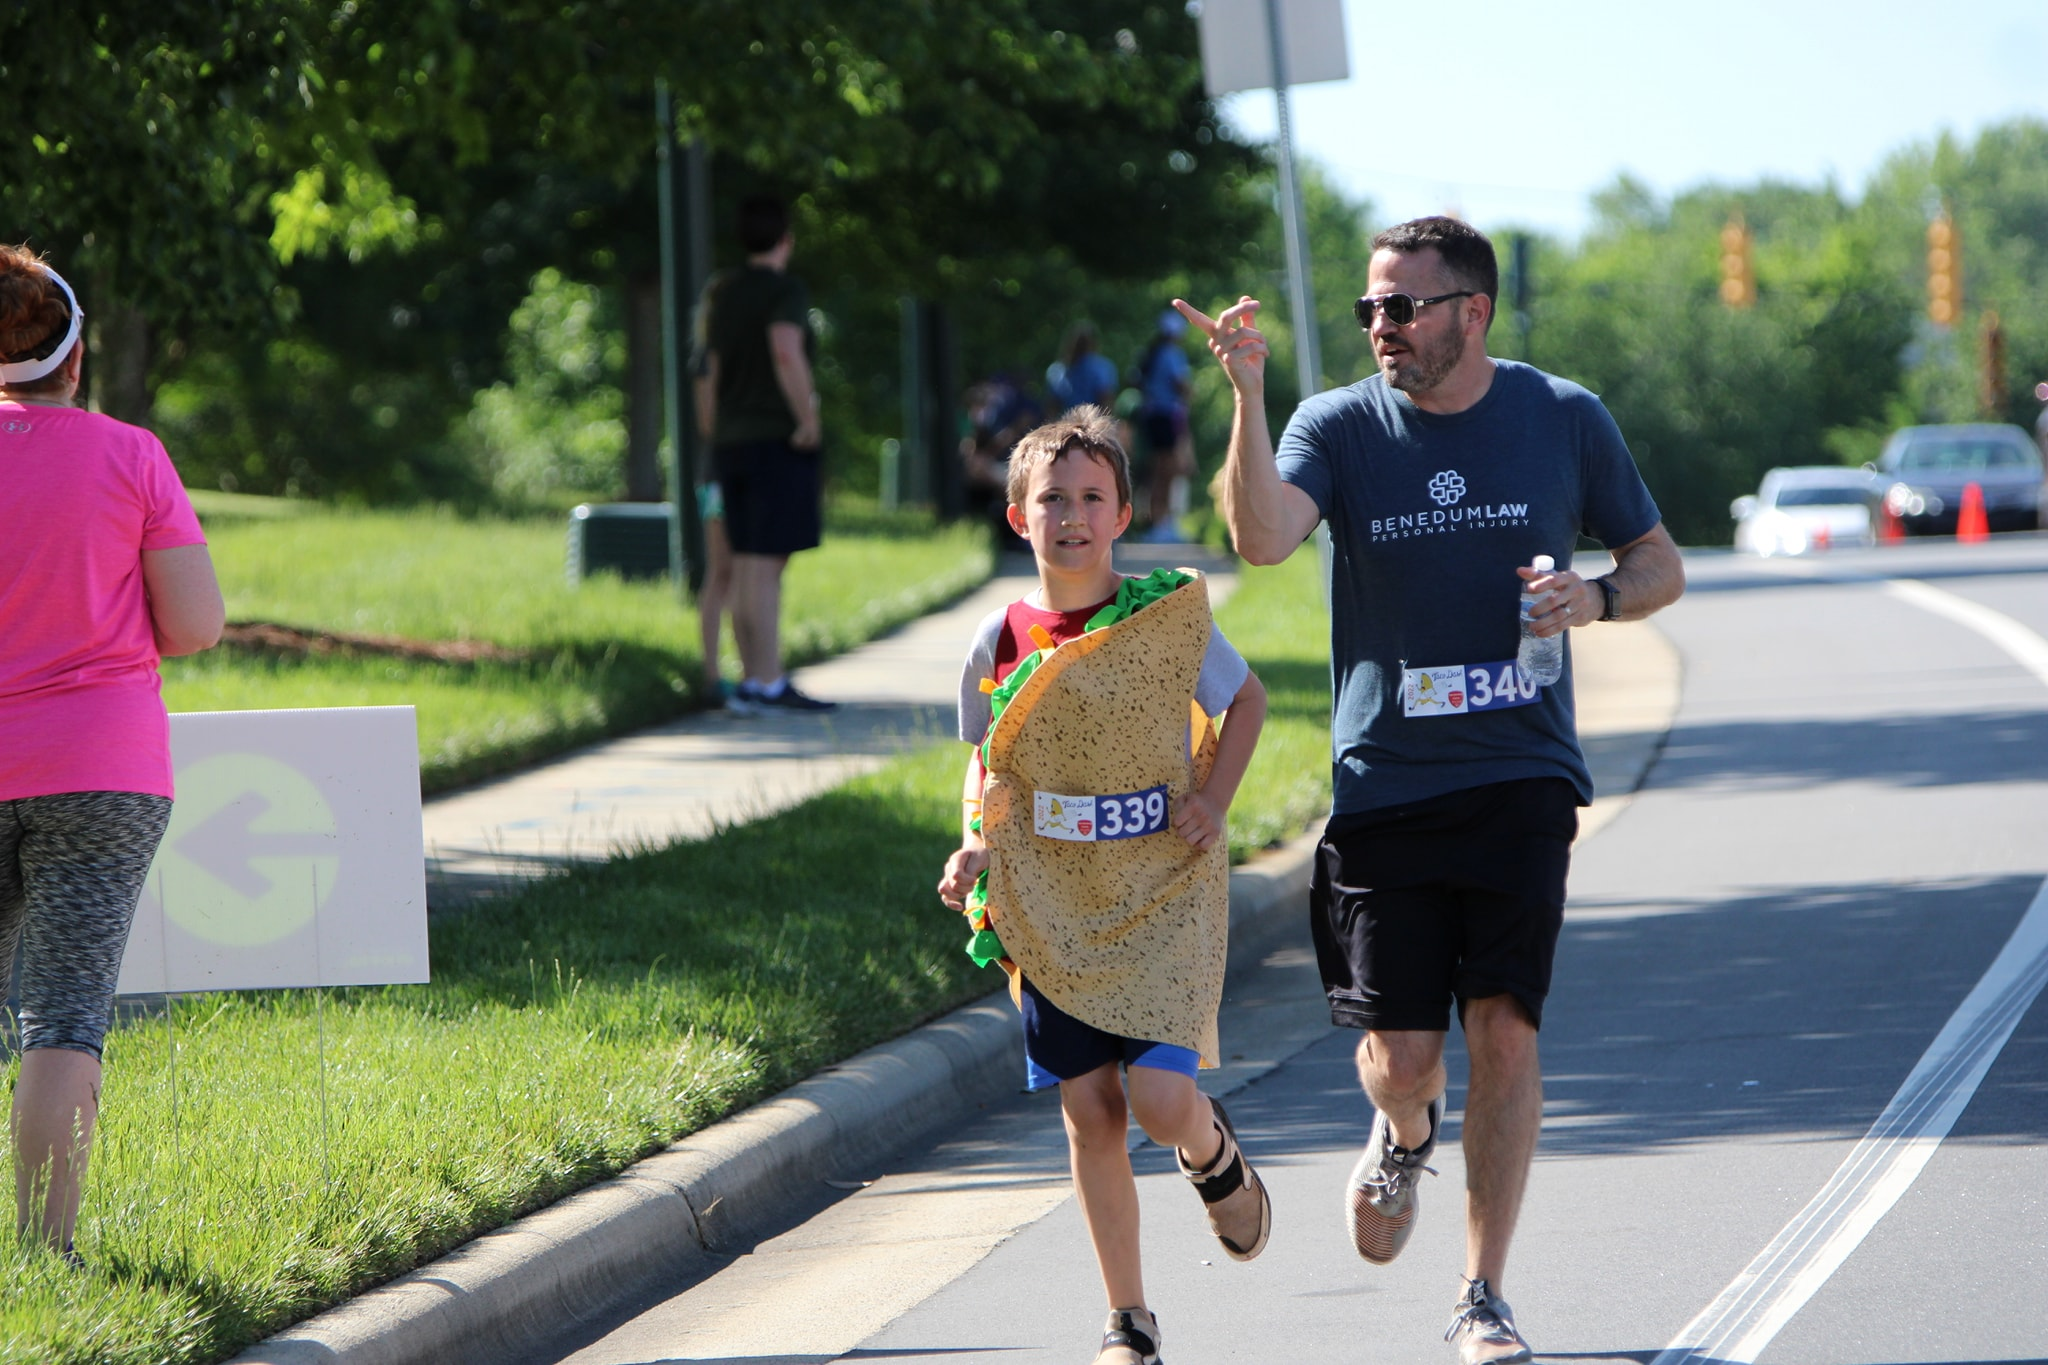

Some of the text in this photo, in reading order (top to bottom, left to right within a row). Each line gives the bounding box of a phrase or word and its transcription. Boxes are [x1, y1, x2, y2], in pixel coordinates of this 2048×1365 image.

[1372, 519, 1530, 543] PERSONAL INJURY
[1100, 792, 1165, 836] 339
